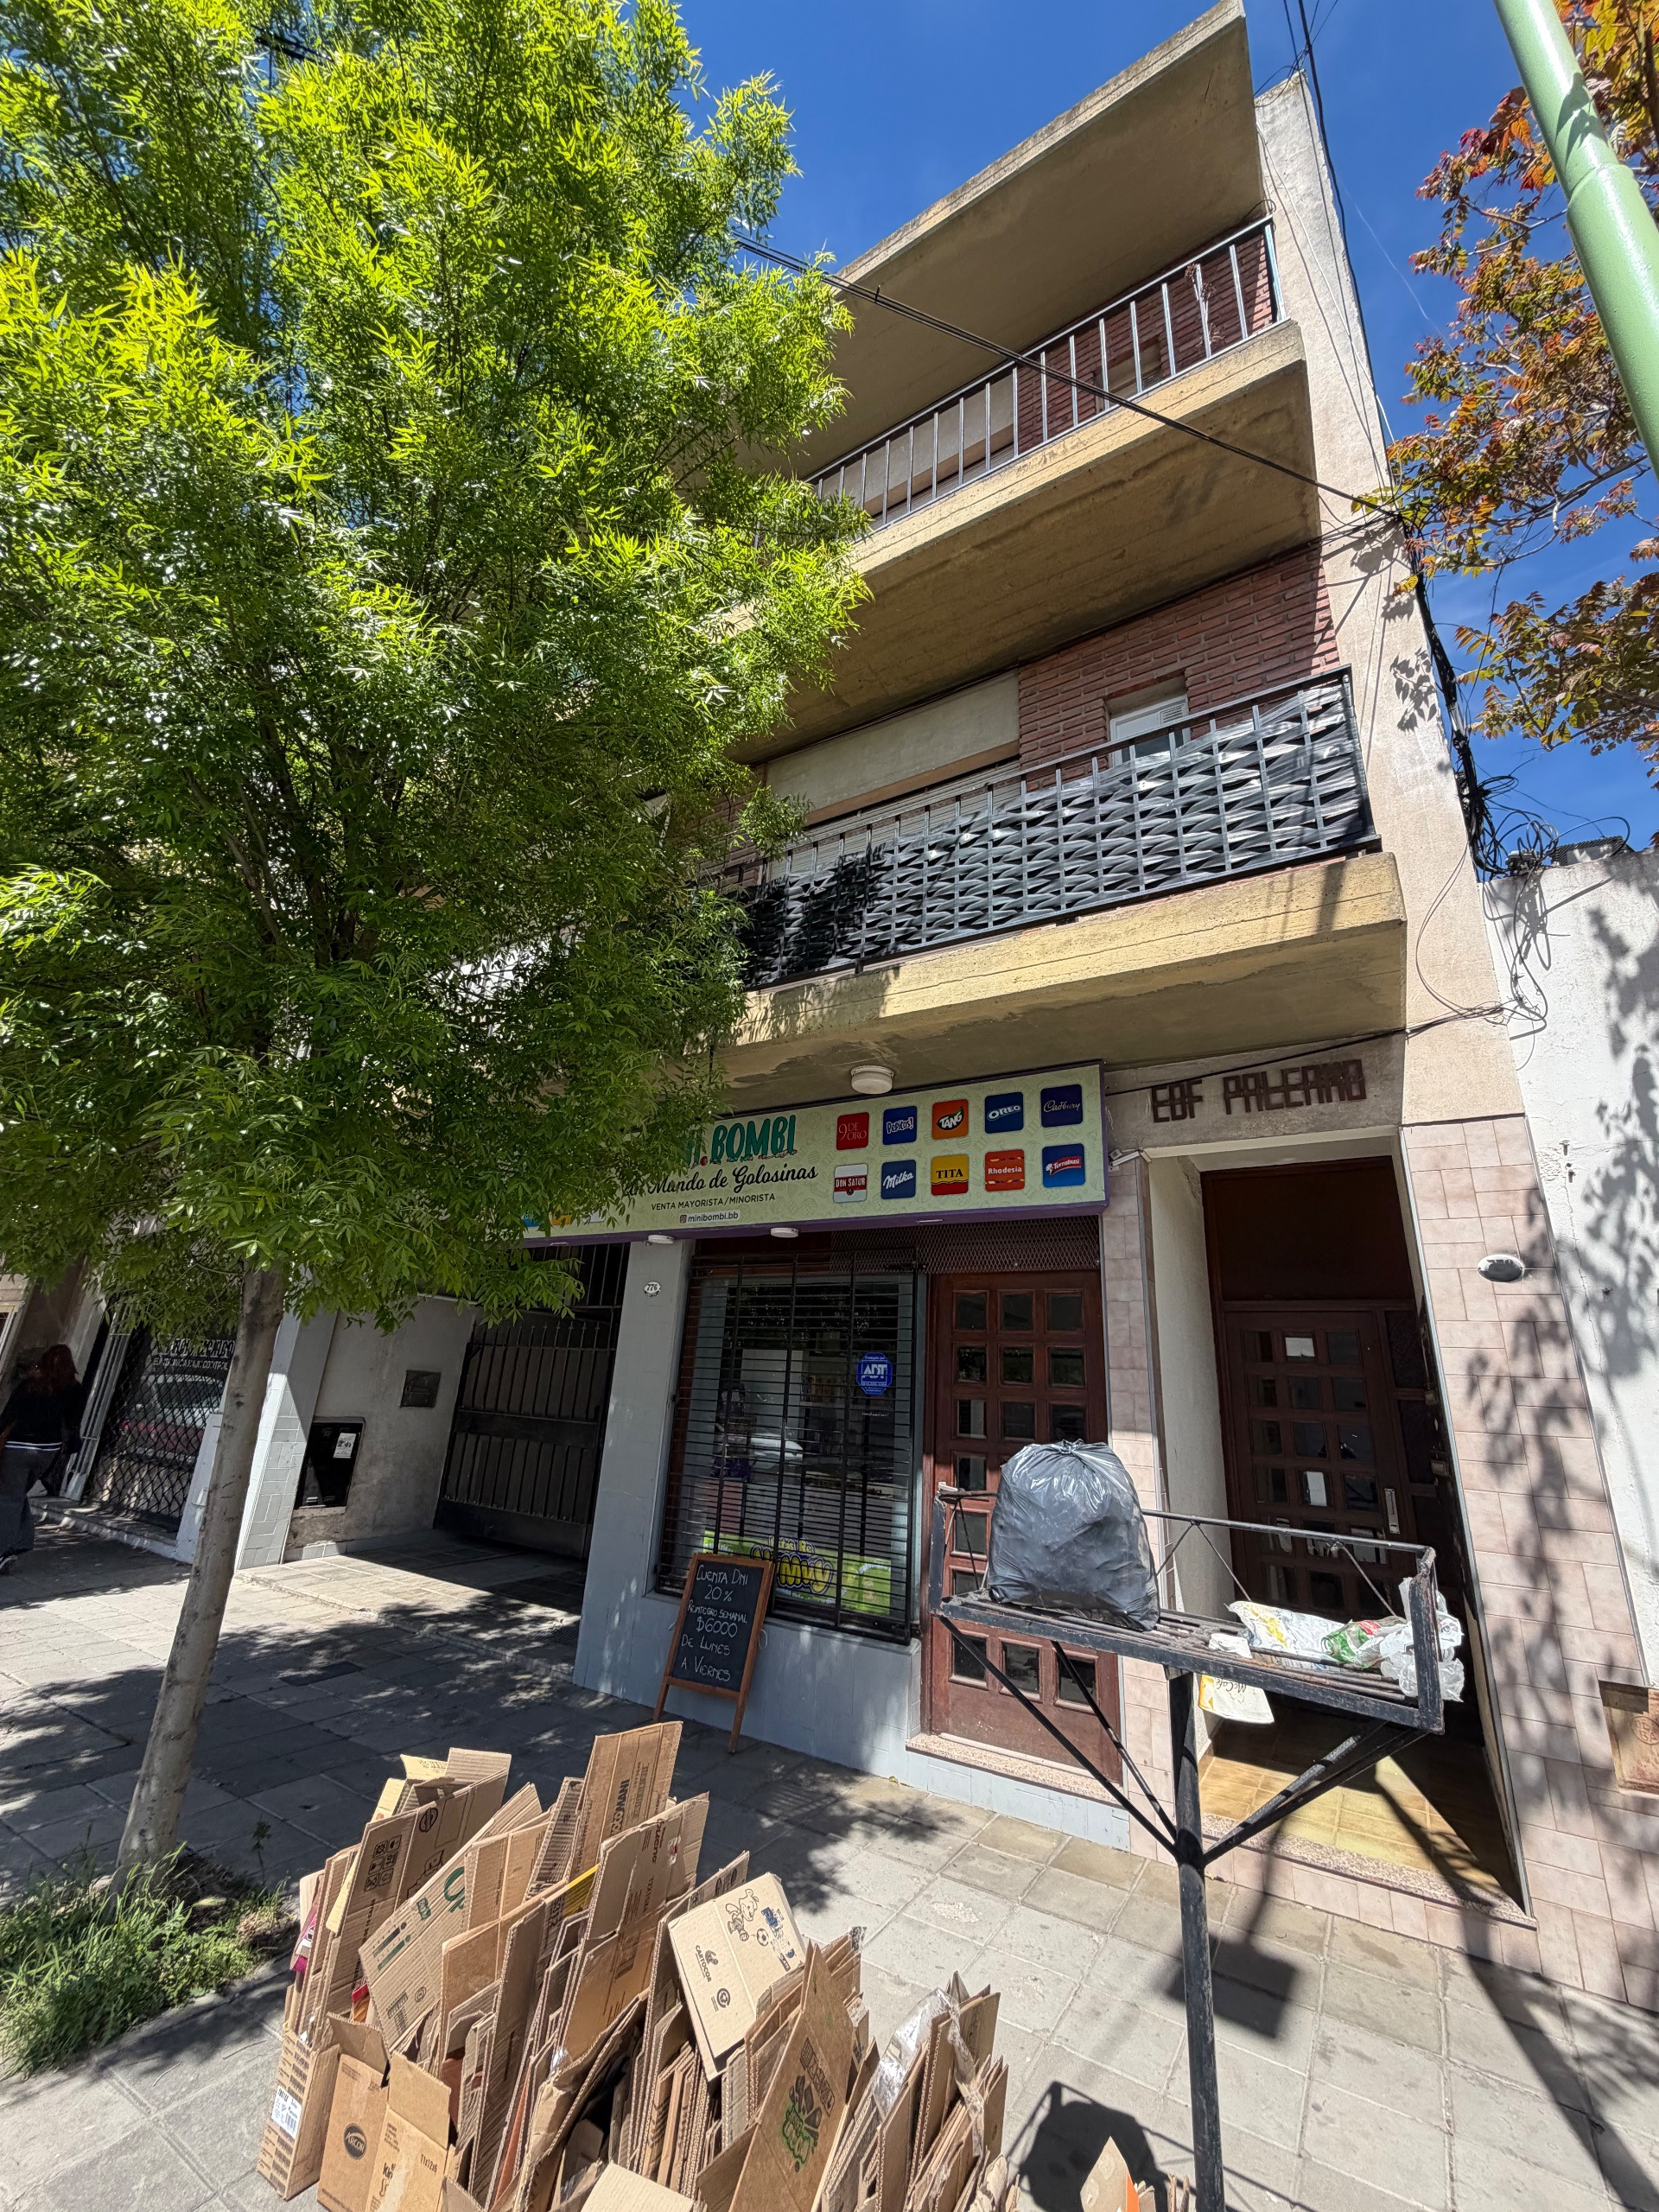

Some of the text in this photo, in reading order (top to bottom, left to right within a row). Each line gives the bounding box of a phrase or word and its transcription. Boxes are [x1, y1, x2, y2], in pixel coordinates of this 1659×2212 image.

[1223, 1059, 1367, 1116] PALERMO
[987, 1105, 1021, 1120] OREO
[1043, 1100, 1081, 1114] Cadbury
[938, 1110, 963, 1129] TANG
[711, 1115, 797, 1164] BOMBI
[1052, 1158, 1080, 1170] Terrabusi
[709, 1168, 728, 1190] de
[733, 1164, 819, 1193] Golosinas
[882, 1171, 914, 1190] Milka
[936, 1168, 963, 1179] TITA
[836, 1179, 847, 1188] DON
[652, 1193, 776, 1211] VENTA MAYORISTA/MINORISTA
[687, 1211, 739, 1224] minibombi.bb
[863, 1363, 888, 1379] ADT
[696, 1616, 738, 1638] $6000
[681, 1656, 688, 1670] A
[695, 1944, 712, 1983] CARTOCOR
